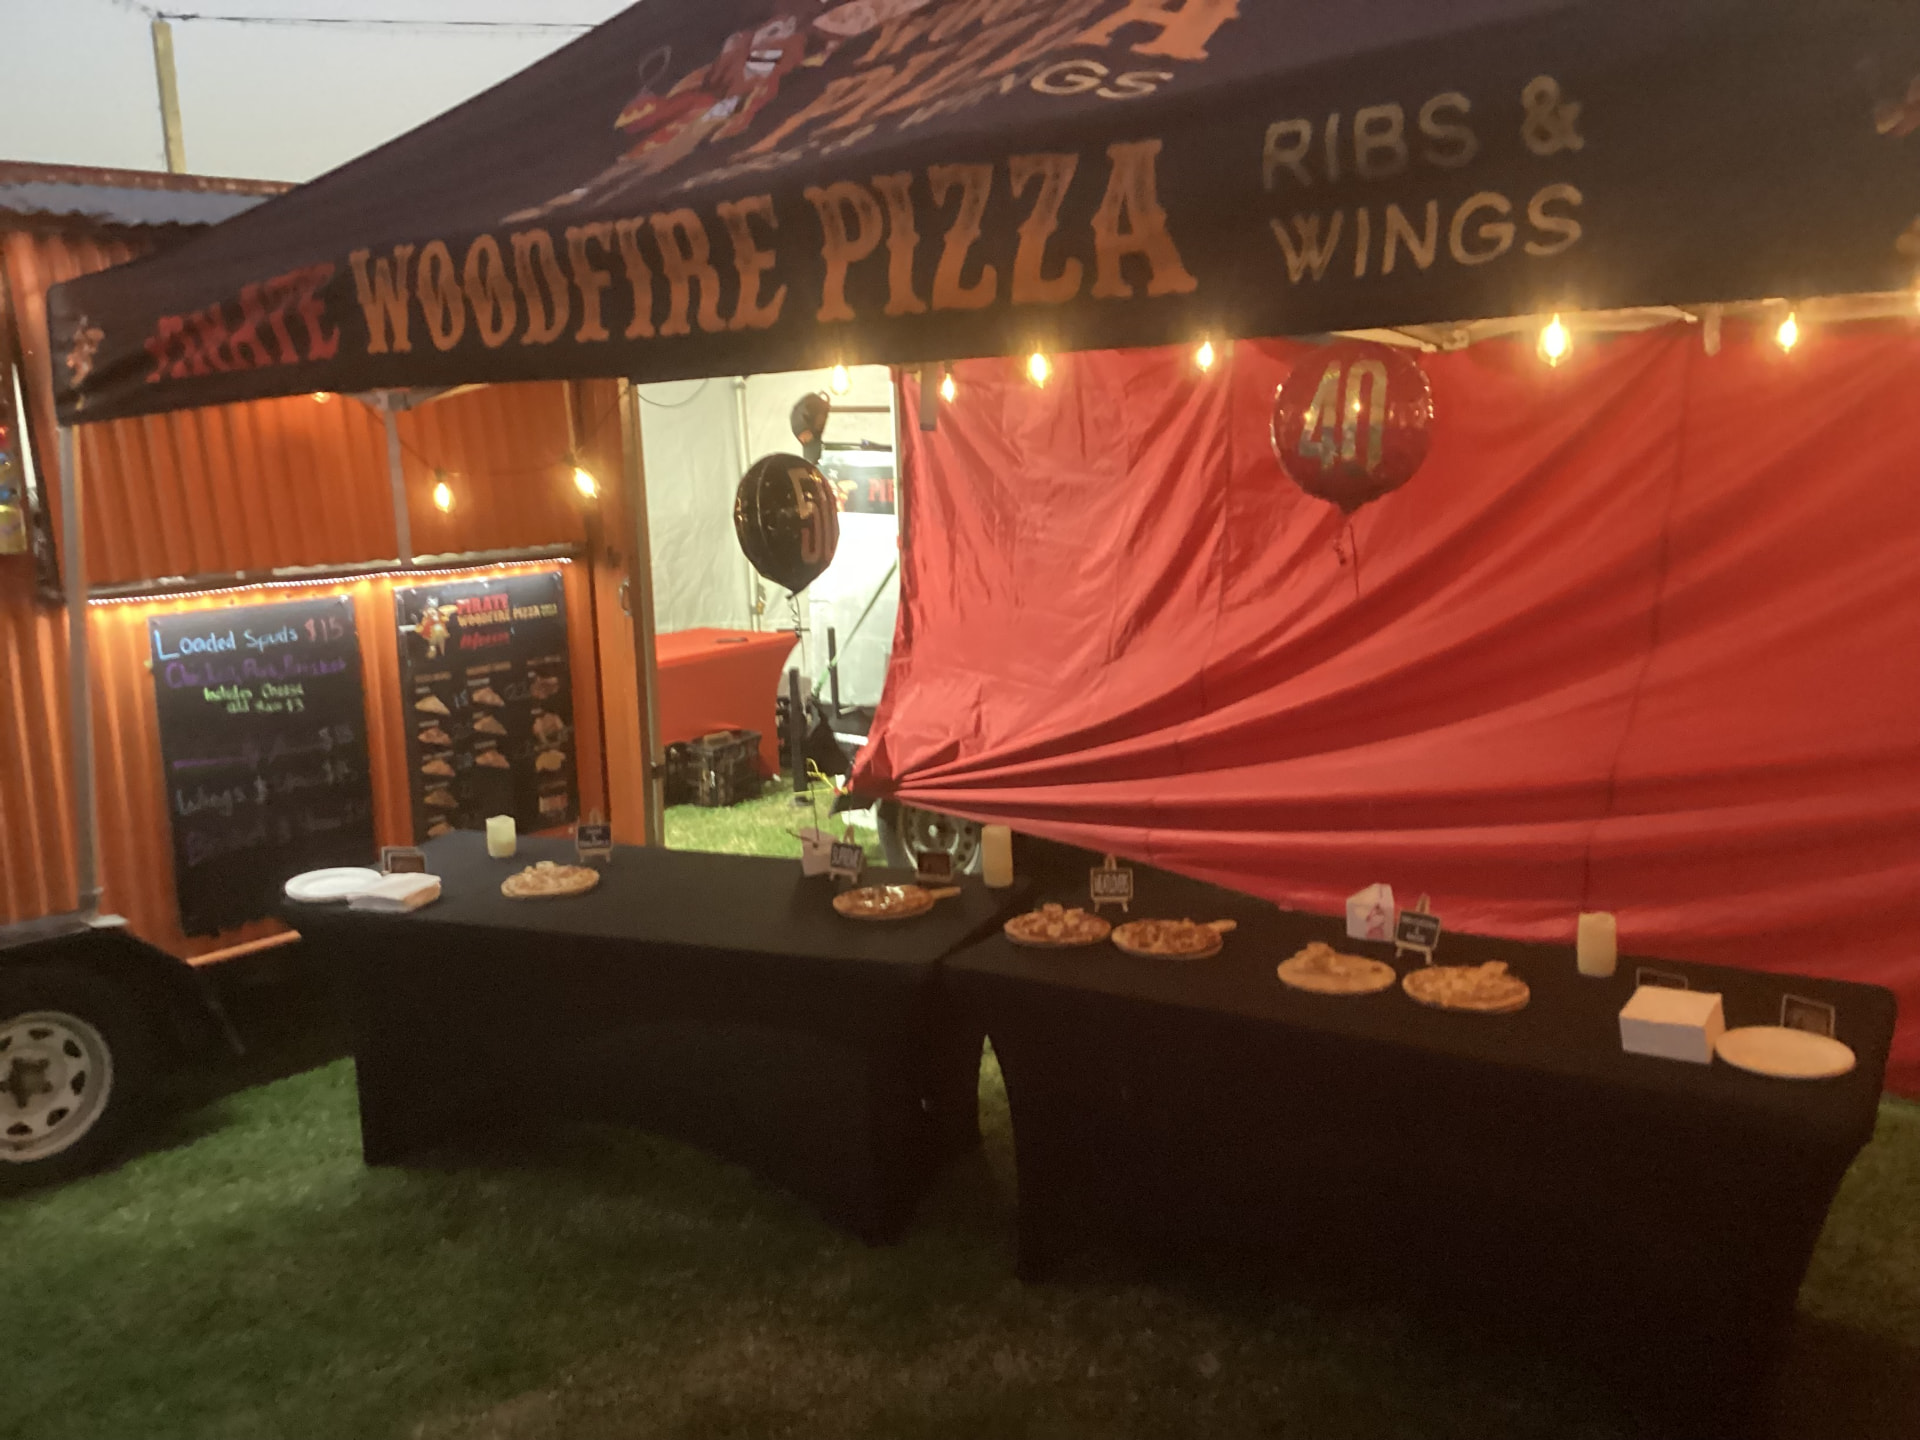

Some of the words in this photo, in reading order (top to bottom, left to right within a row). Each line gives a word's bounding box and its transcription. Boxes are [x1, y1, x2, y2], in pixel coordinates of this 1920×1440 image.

[1262, 92, 1480, 191] RIBS
[1521, 75, 1585, 155] &
[350, 195, 787, 356] WOODFIRE
[803, 139, 1198, 324] PIZZA
[1270, 183, 1584, 284] WINGS
[1299, 361, 1389, 470] 40
[154, 630, 235, 660] Loaded
[243, 626, 298, 652] Spuds
